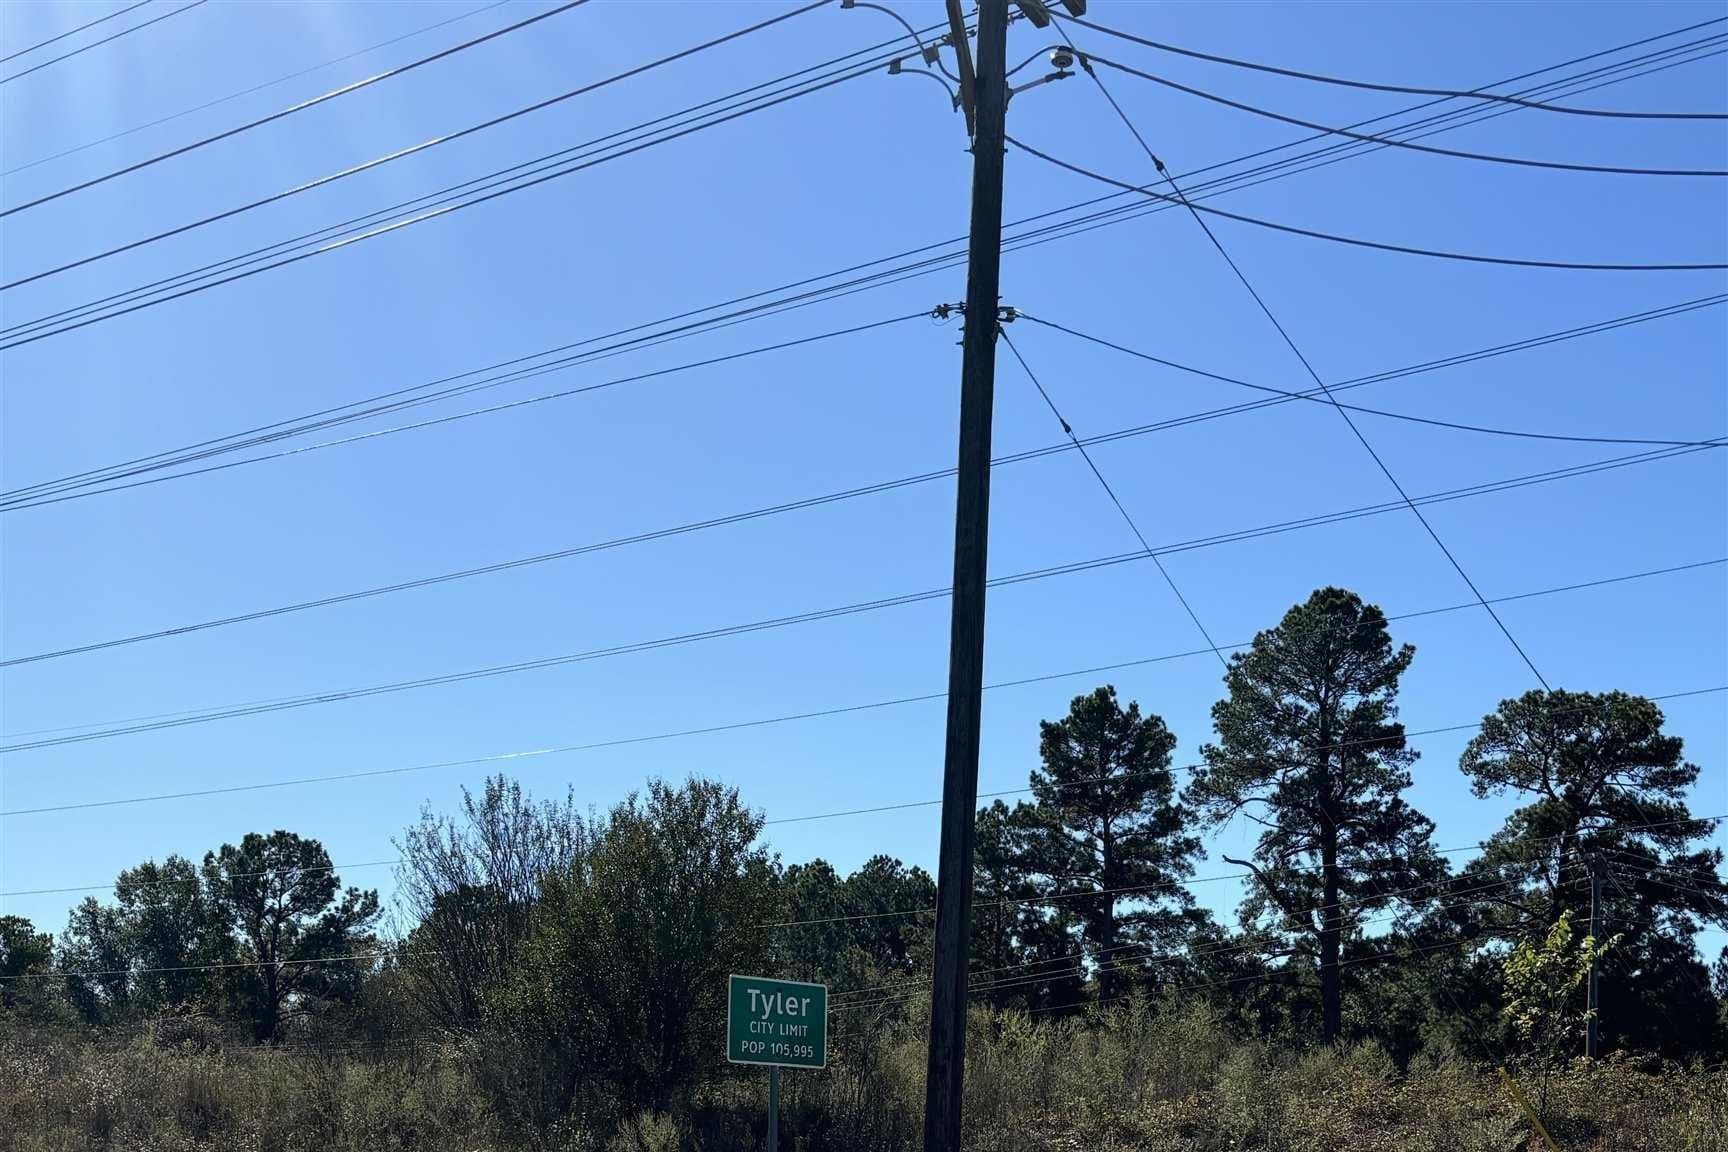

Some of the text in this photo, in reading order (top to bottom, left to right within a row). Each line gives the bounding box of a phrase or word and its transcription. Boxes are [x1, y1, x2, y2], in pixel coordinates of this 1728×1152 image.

[747, 988, 810, 1019] Tyler
[750, 1021, 808, 1037] CITY LIMIT
[741, 1040, 813, 1057] POP 105,995
